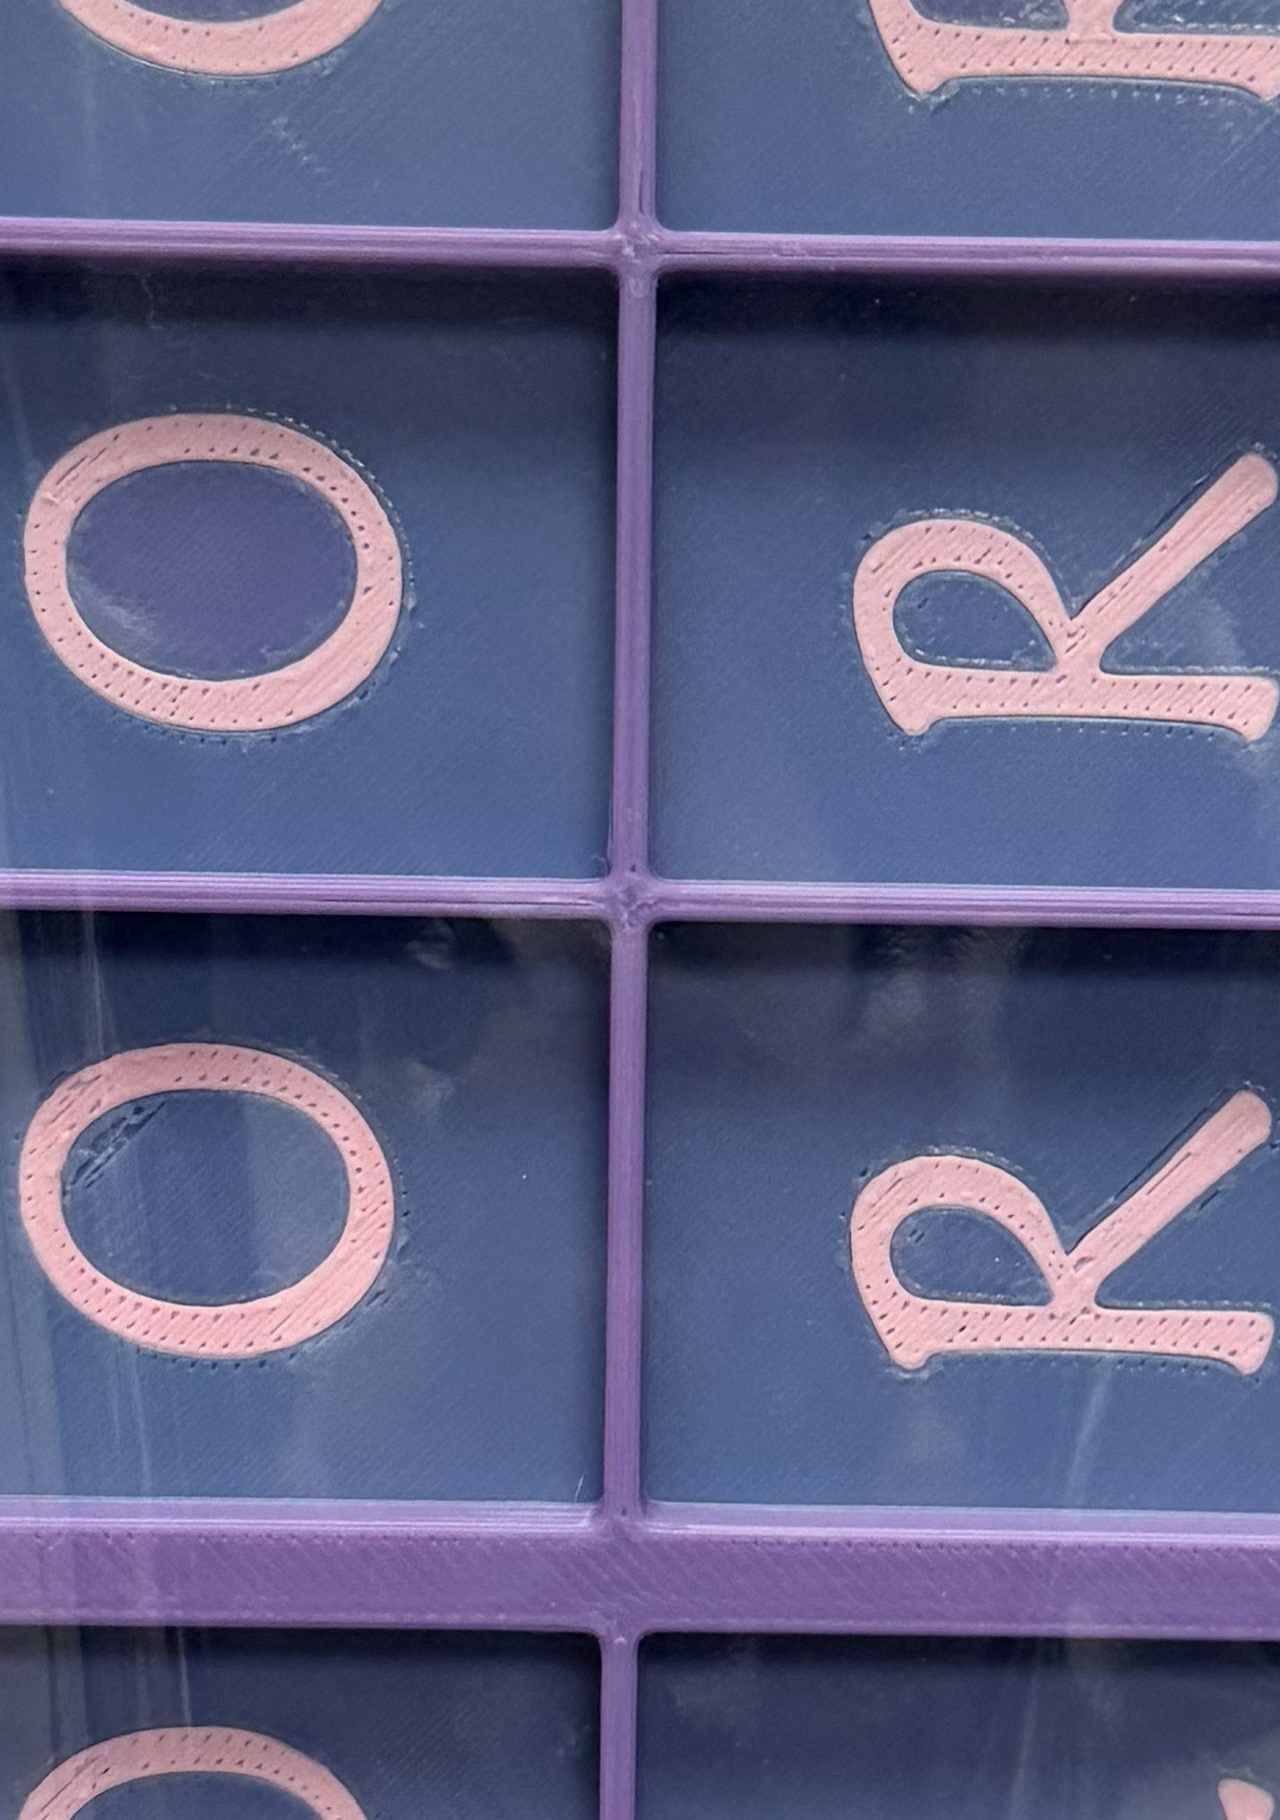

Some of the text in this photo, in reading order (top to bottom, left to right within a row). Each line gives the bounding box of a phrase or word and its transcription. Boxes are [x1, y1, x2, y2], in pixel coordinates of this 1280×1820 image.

[22, 412, 404, 733] O
[852, 451, 1280, 740] R
[17, 1041, 397, 1361] O
[849, 1089, 1275, 1375] R
